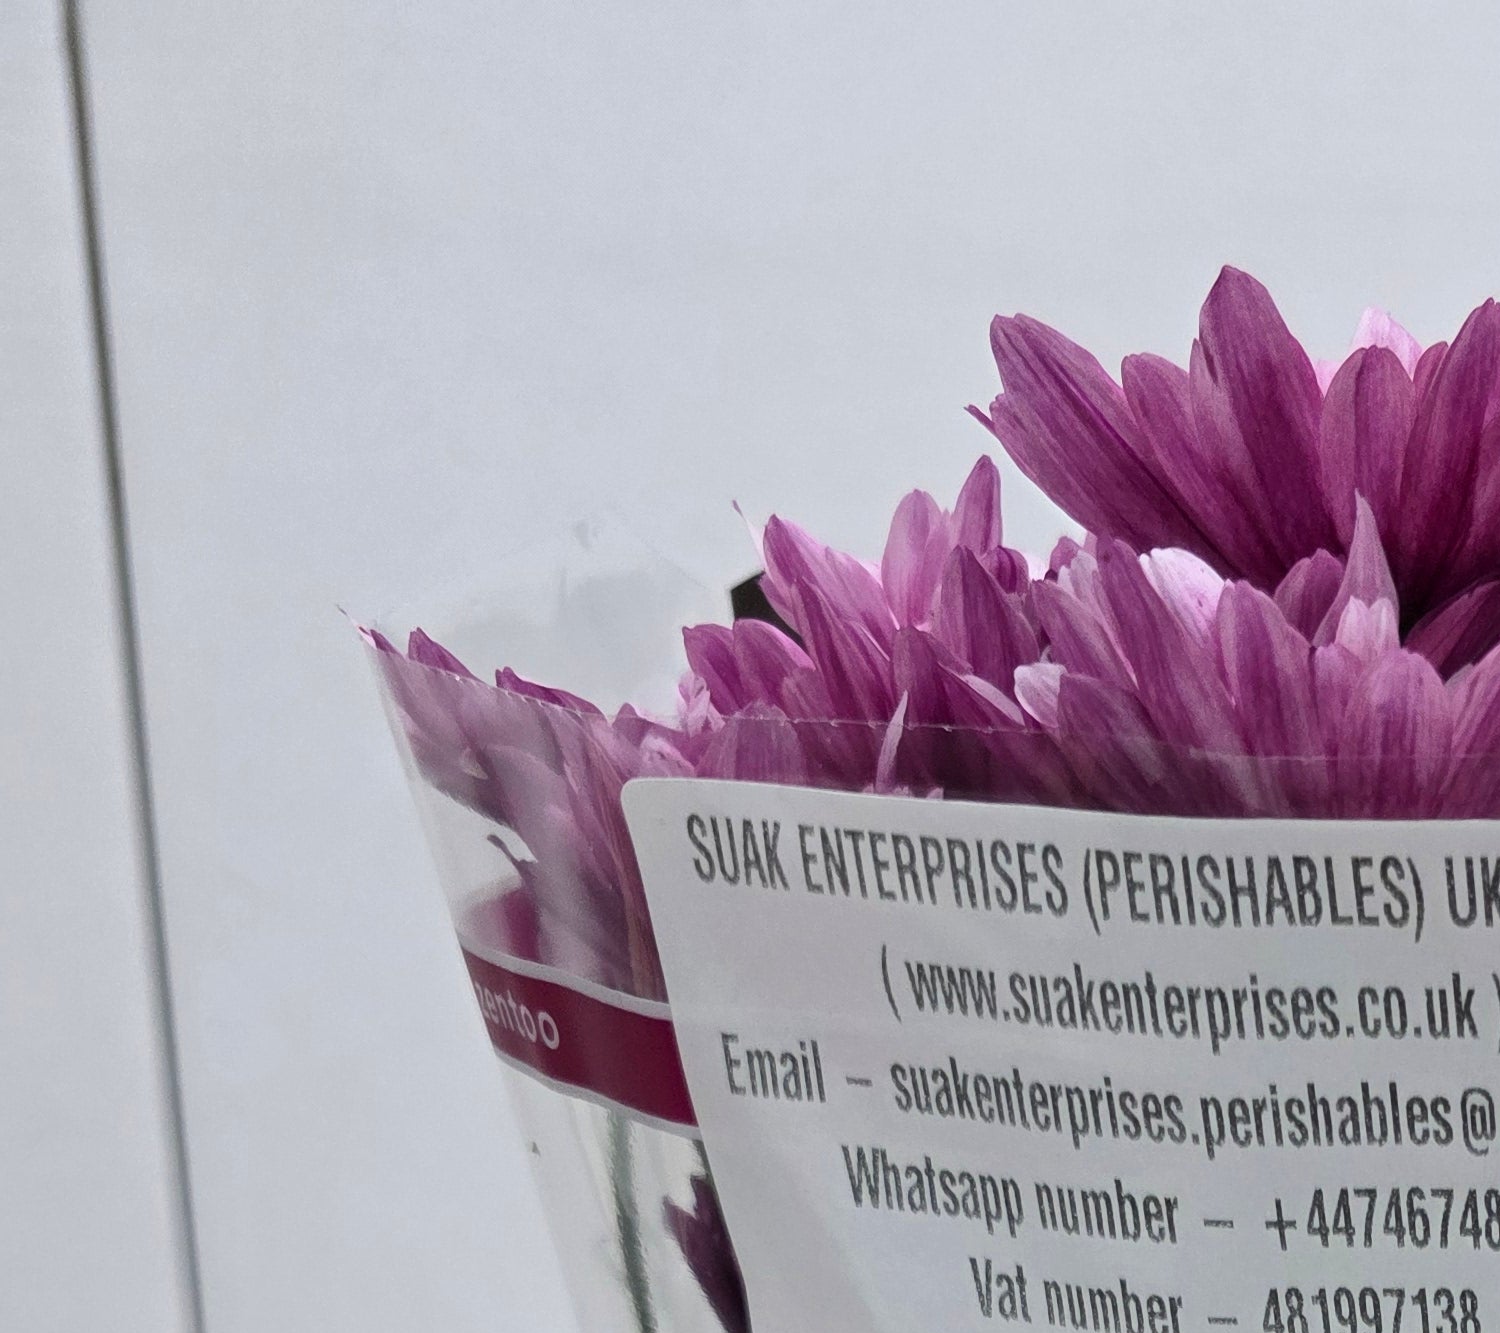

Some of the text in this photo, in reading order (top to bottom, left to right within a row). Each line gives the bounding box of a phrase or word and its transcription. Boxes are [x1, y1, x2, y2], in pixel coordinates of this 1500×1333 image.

[687, 813, 790, 891] SUAK
[798, 824, 1068, 917] ENTERPRISES
[1083, 847, 1425, 943] (PERISHABLES)
[475, 981, 560, 1050] zentoo
[904, 960, 1480, 1056] www.suakenterprises.co.uk
[721, 1031, 827, 1104] Email
[841, 1144, 1025, 1238] Whatsapp
[1034, 1178, 1178, 1244] number
[969, 1255, 1032, 1323] Vat
